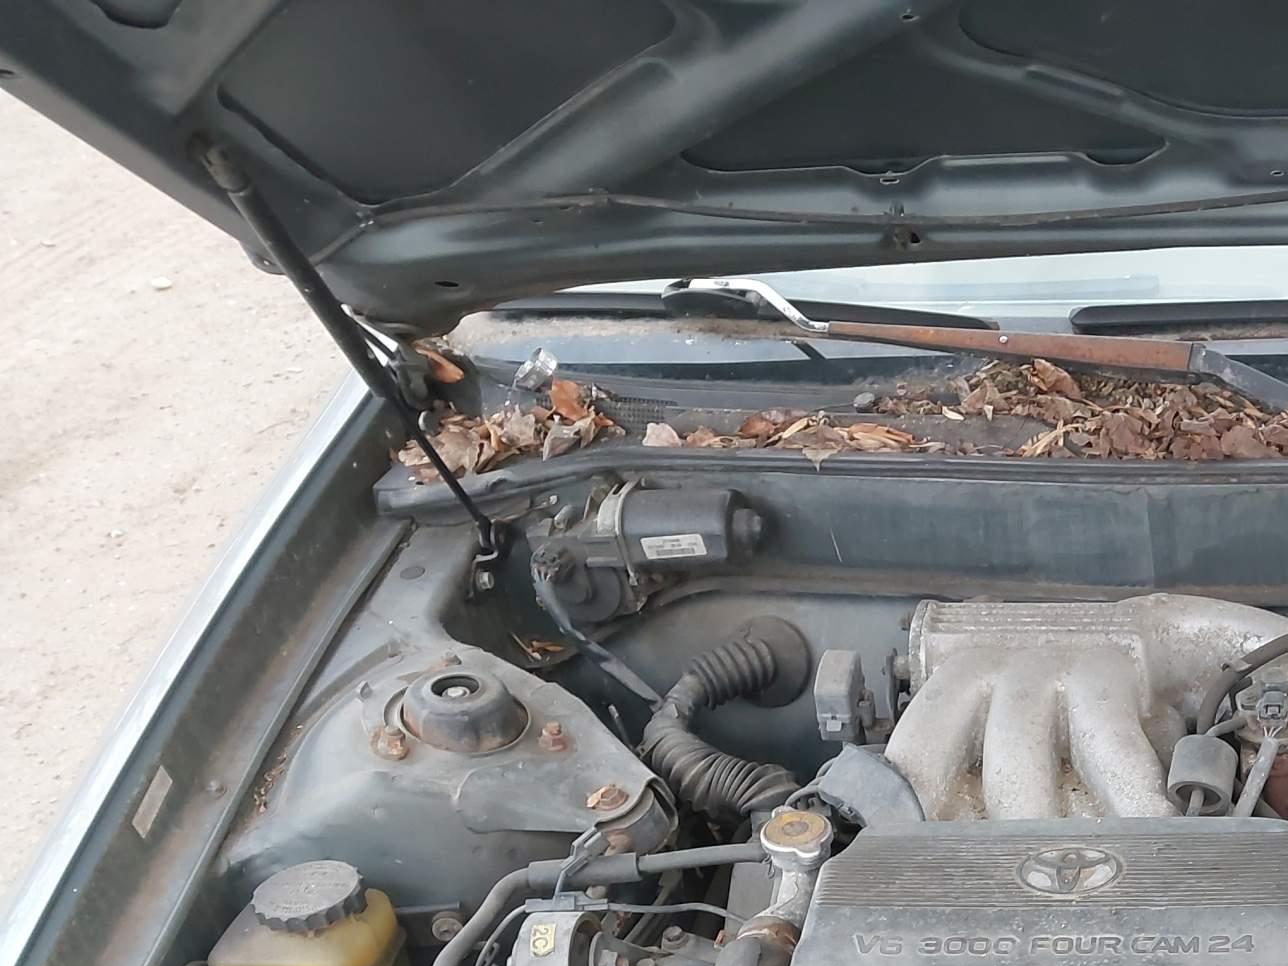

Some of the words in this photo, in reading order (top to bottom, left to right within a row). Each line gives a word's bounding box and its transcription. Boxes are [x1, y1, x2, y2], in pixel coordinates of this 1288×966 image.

[854, 934, 903, 955] V6
[918, 935, 1018, 955] 3000
[1030, 935, 1122, 955] FOUR
[1131, 935, 1200, 954] CAM
[1208, 934, 1254, 953] 24
